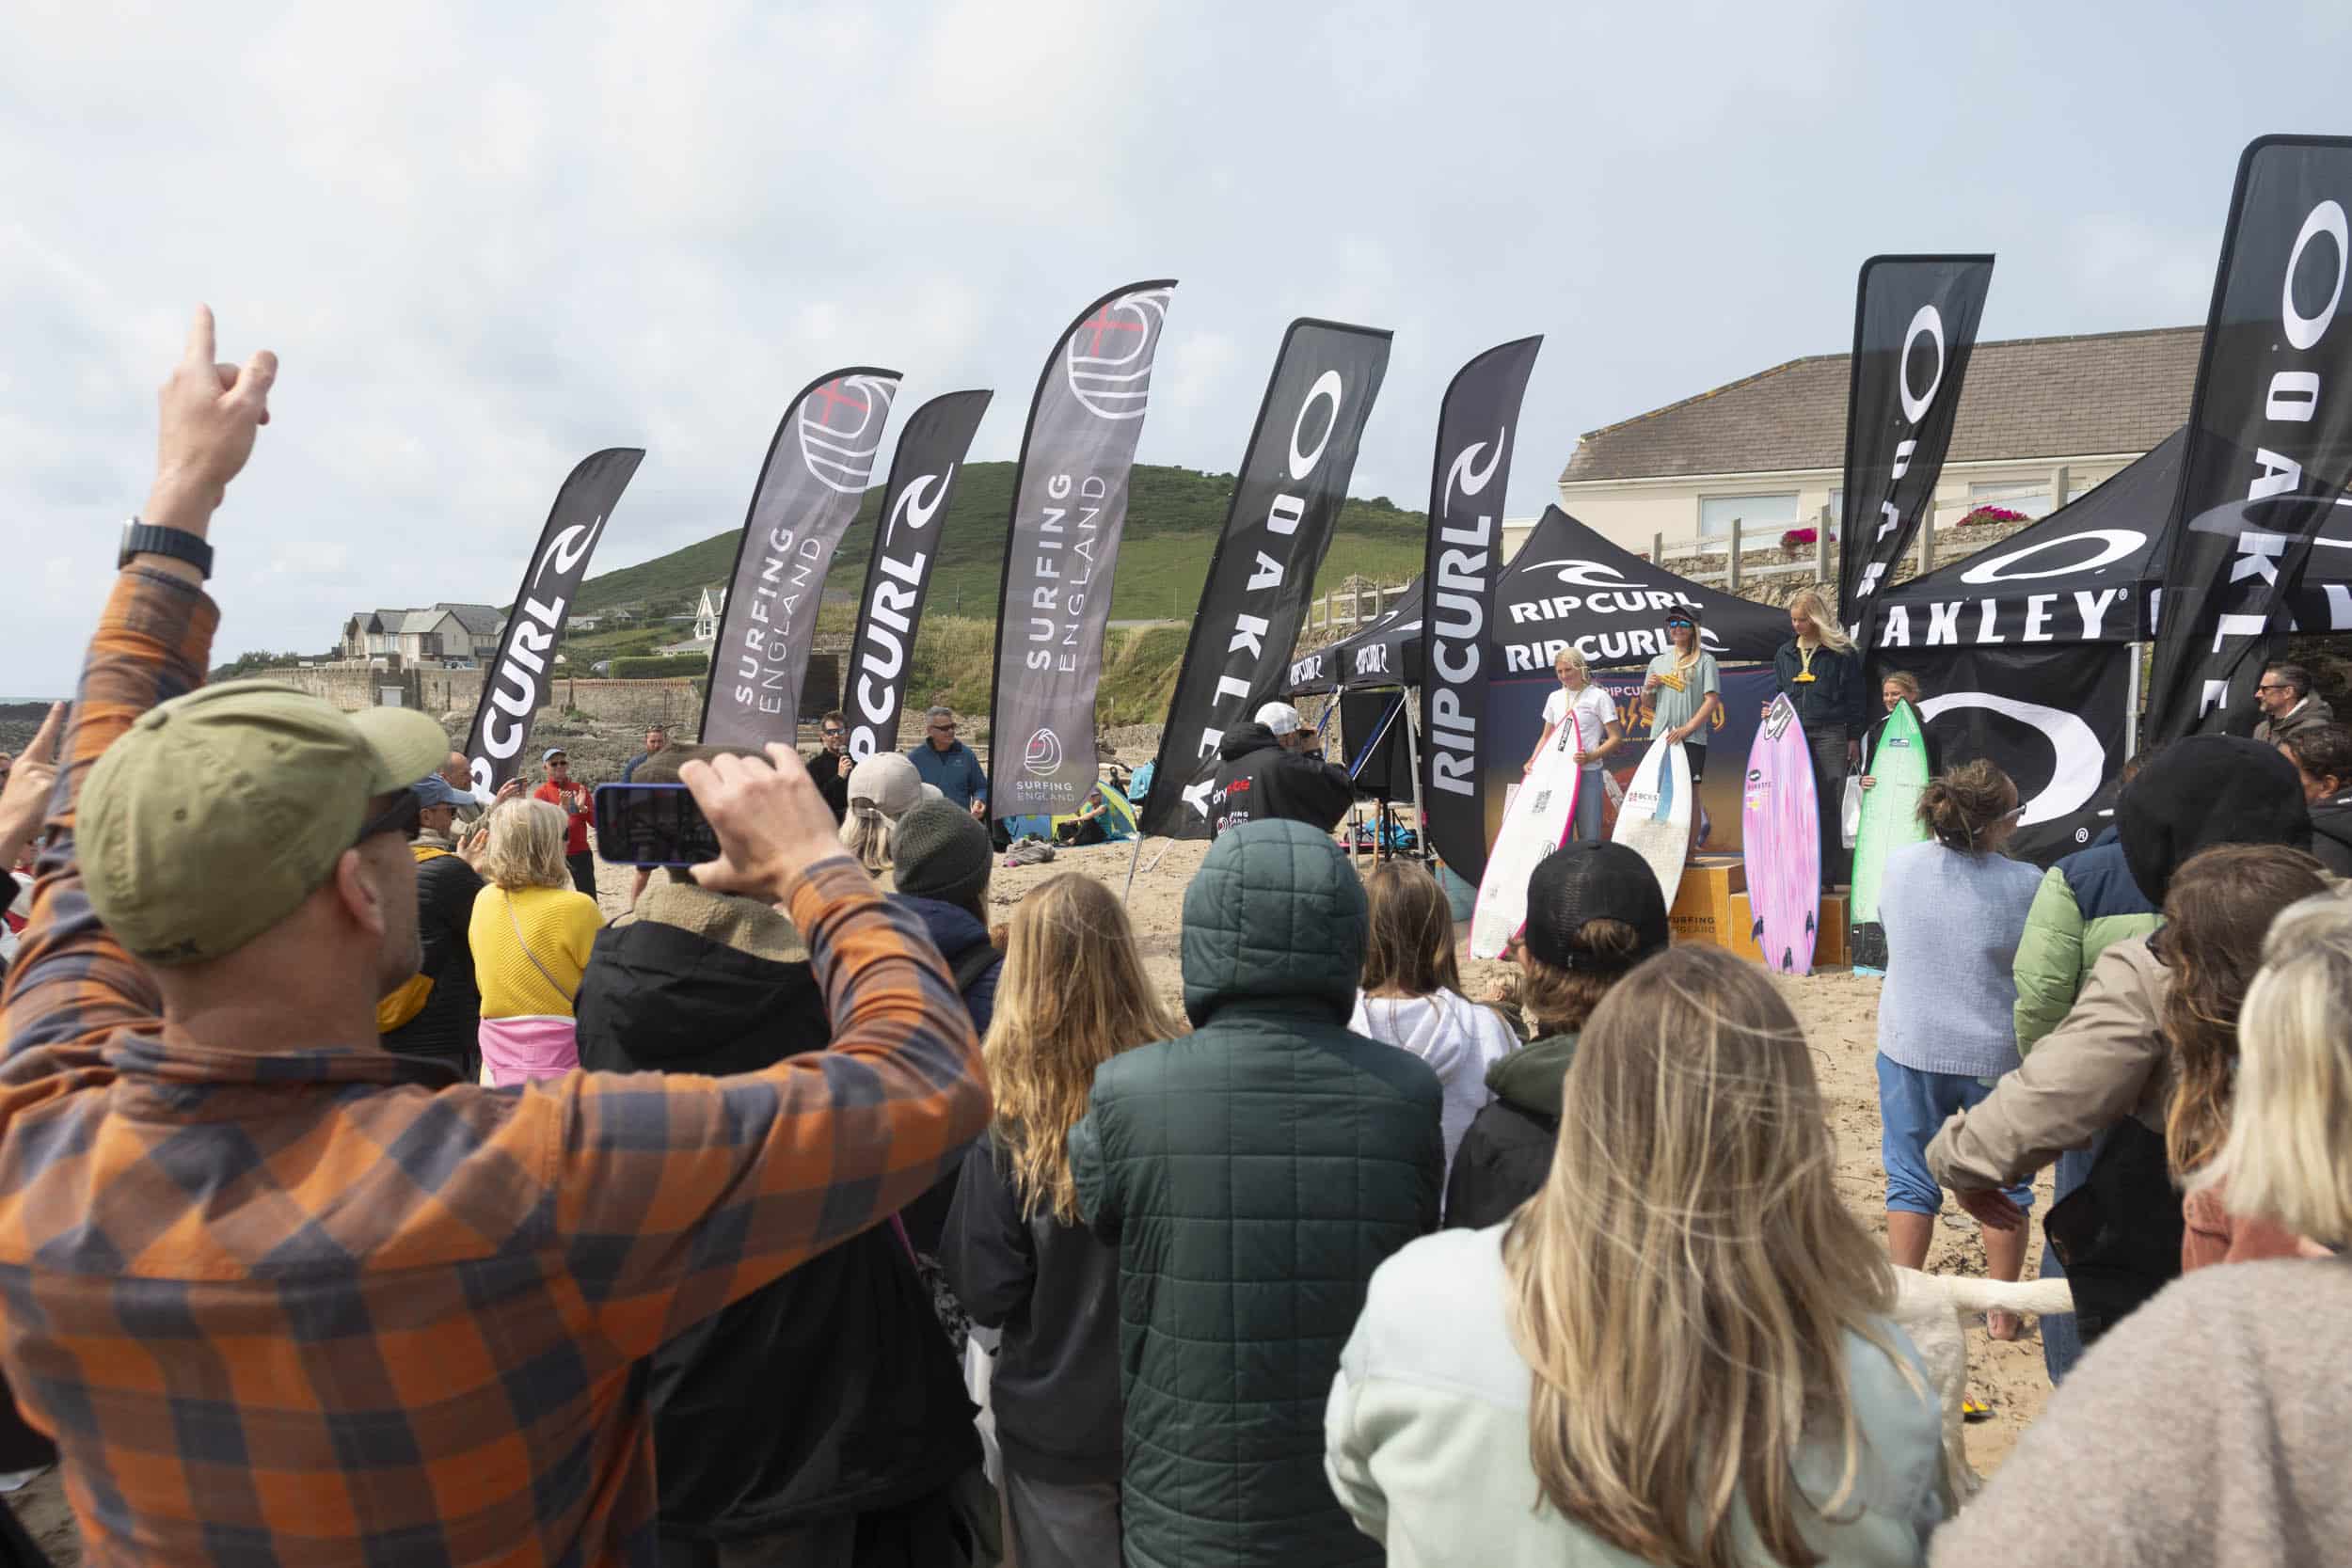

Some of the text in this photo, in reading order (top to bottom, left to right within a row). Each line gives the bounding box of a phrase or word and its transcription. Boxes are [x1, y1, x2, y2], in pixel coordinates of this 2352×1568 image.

[735, 527, 794, 705] SURFING
[759, 538, 821, 714] ENGLAND
[1025, 473, 1073, 671] SURFING
[1058, 476, 1106, 673] ENGLAND
[2198, 371, 2320, 721] OAKLE
[1624, 686, 1643, 696] CU
[1016, 781, 1073, 791] SURFING
[1672, 917, 1716, 926] URFING
